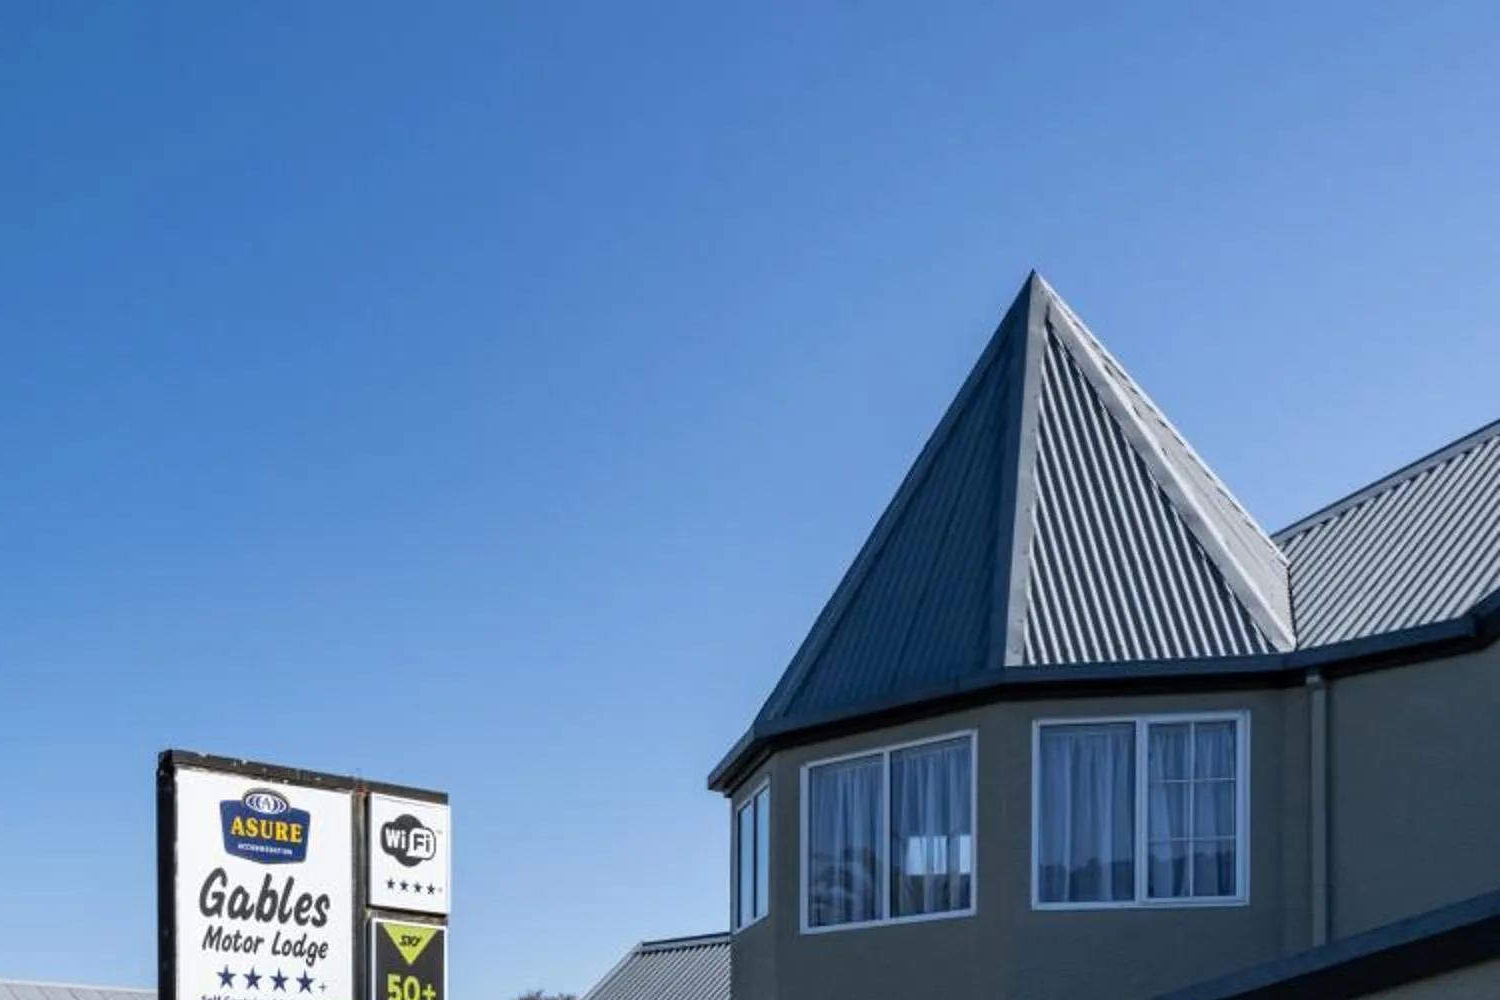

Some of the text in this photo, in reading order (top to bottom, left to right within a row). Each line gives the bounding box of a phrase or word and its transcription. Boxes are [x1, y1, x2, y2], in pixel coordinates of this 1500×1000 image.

[230, 816, 302, 843] ASURE
[199, 867, 331, 928] Gables
[202, 924, 329, 967] Motor Lodge
